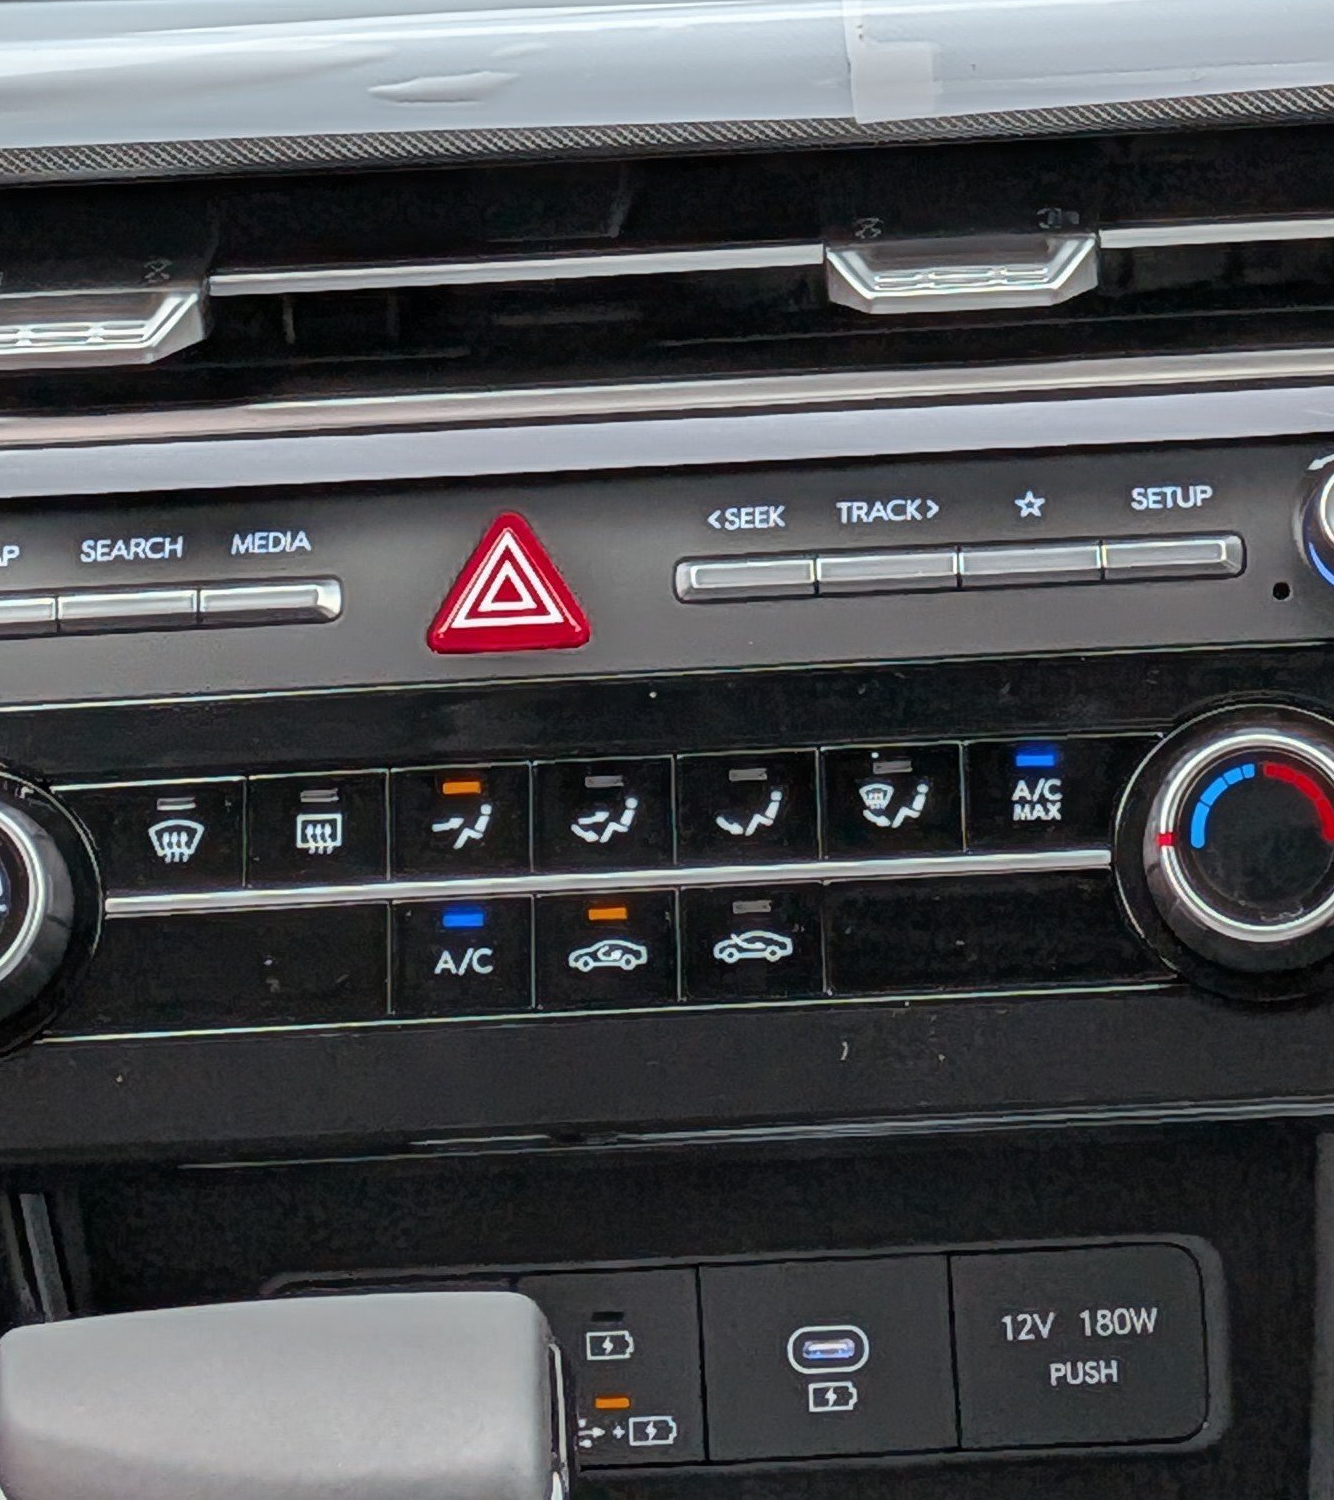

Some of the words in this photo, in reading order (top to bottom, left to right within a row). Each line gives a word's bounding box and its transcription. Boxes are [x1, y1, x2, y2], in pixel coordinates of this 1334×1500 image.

[1132, 486, 1212, 510] SETUP
[81, 537, 182, 562] SEARCH
[231, 531, 311, 554] MEDIA
[1012, 778, 1062, 802] A/C
[1013, 802, 1061, 820] MAX
[435, 948, 493, 975] A/C
[1002, 1312, 1054, 1340] 12V
[1080, 1308, 1157, 1336] 180W
[1050, 1360, 1117, 1386] PUSH
